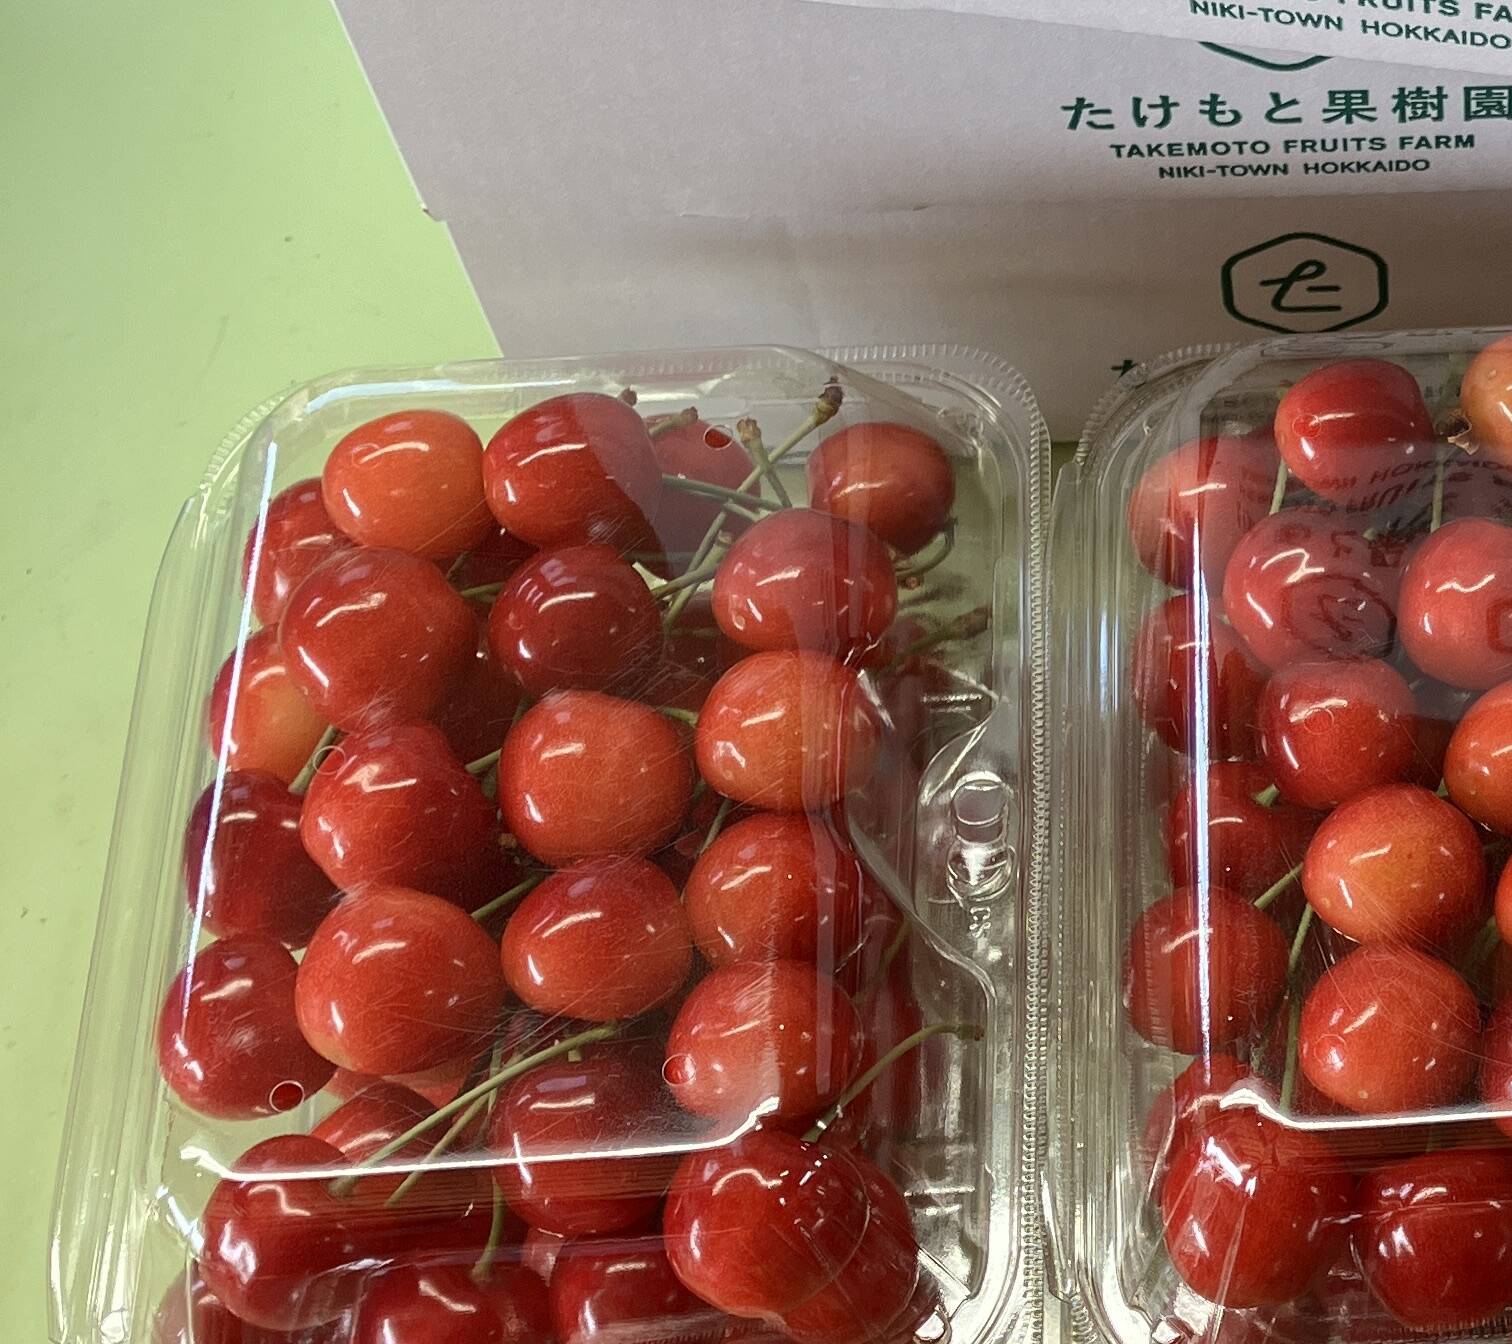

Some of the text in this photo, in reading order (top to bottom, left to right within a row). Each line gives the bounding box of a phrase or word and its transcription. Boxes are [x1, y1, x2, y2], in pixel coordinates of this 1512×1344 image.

[1190, 0, 1511, 49] NIKI-TOWN HOKKAIDO
[1109, 134, 1474, 158] TAKEMOTO FRUITS FARM
[1159, 159, 1430, 179] NIKI-TOWN HOKKAIDO
